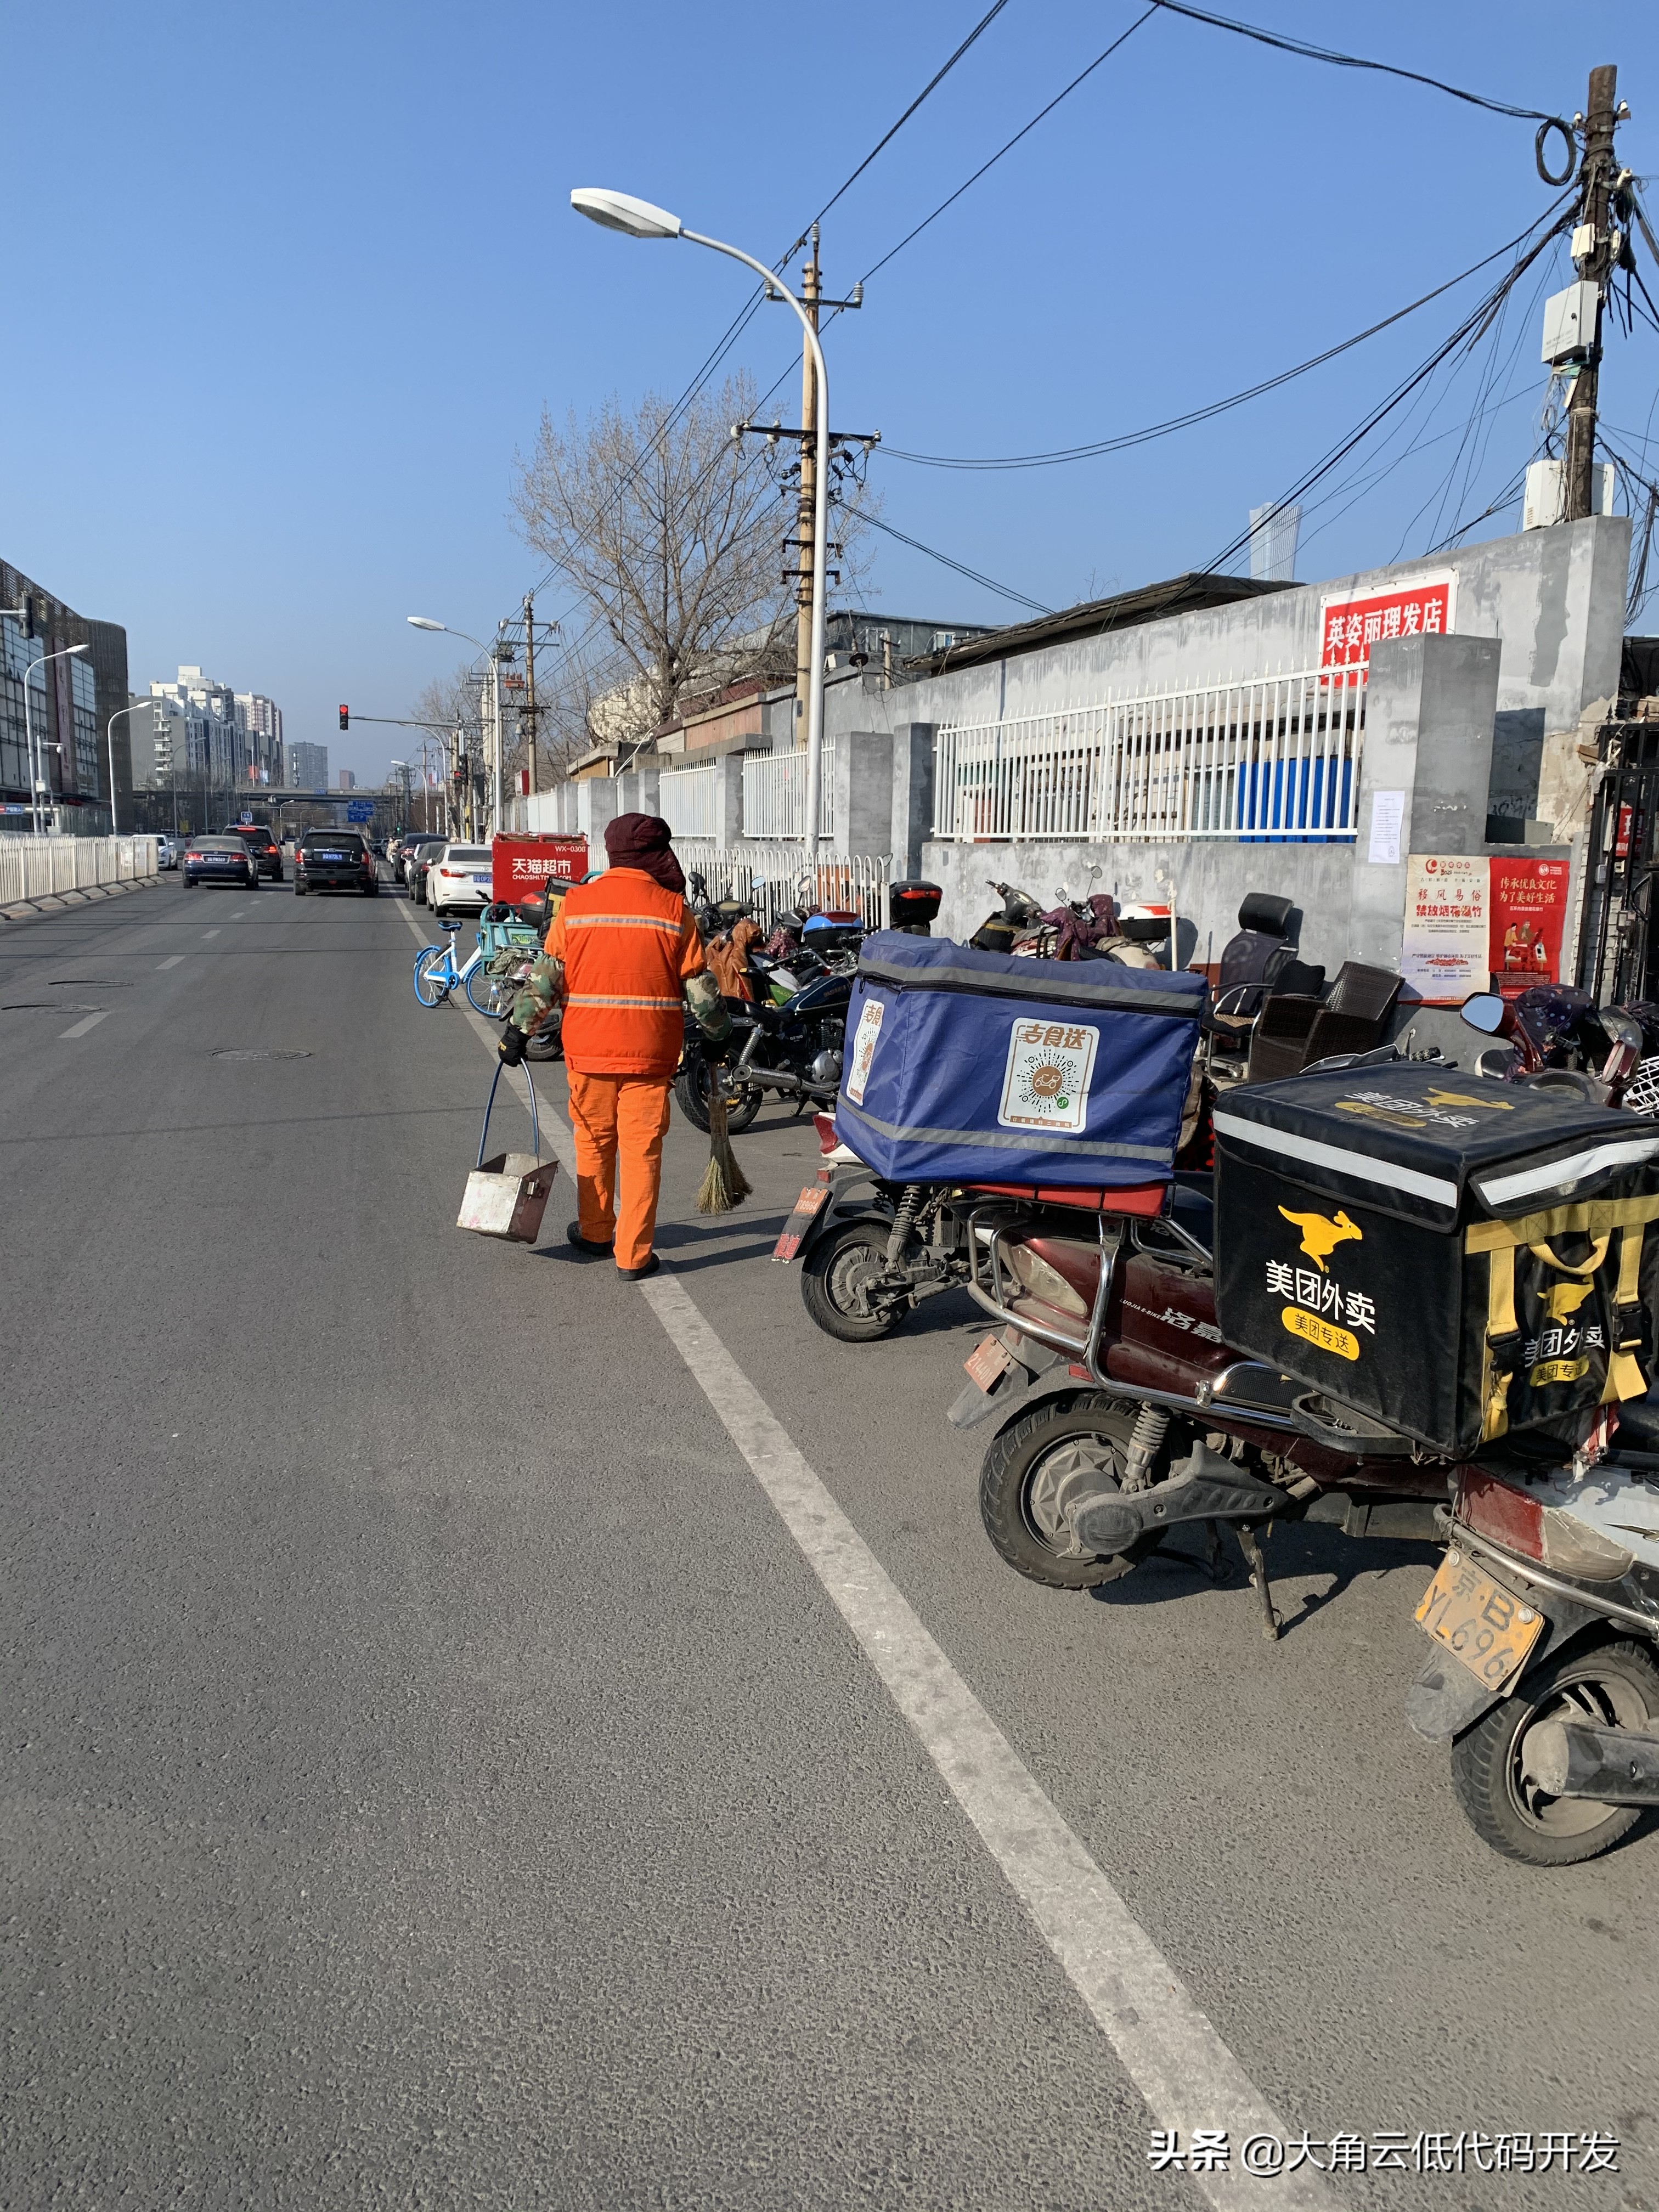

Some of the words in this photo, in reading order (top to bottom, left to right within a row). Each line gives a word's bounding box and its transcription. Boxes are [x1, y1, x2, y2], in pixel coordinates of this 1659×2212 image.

[1326, 597, 1443, 651] 英姿丽理发店
[512, 858, 571, 874] 天猫超市
[1500, 876, 1557, 890] 传承优良文化
[1418, 888, 1482, 901] 移风易俗
[1499, 890, 1556, 904] 为了美好生活
[1416, 904, 1482, 918] 禁放烟花爆竹
[1344, 1091, 1480, 1128] 美团外卖
[1012, 1116, 1070, 1128] 订餐请扫二维码
[1266, 1259, 1375, 1335] 美团外卖
[1119, 1298, 1141, 1311] LUOJIA
[1141, 1307, 1163, 1319] E-BIKE
[1159, 1307, 1222, 1344] 洛嘉
[1294, 1313, 1350, 1353] 美团专送
[1524, 1323, 1605, 1368] 美团外卖
[1536, 1361, 1583, 1383] 美团专送
[1423, 1584, 1514, 1679] YL696
